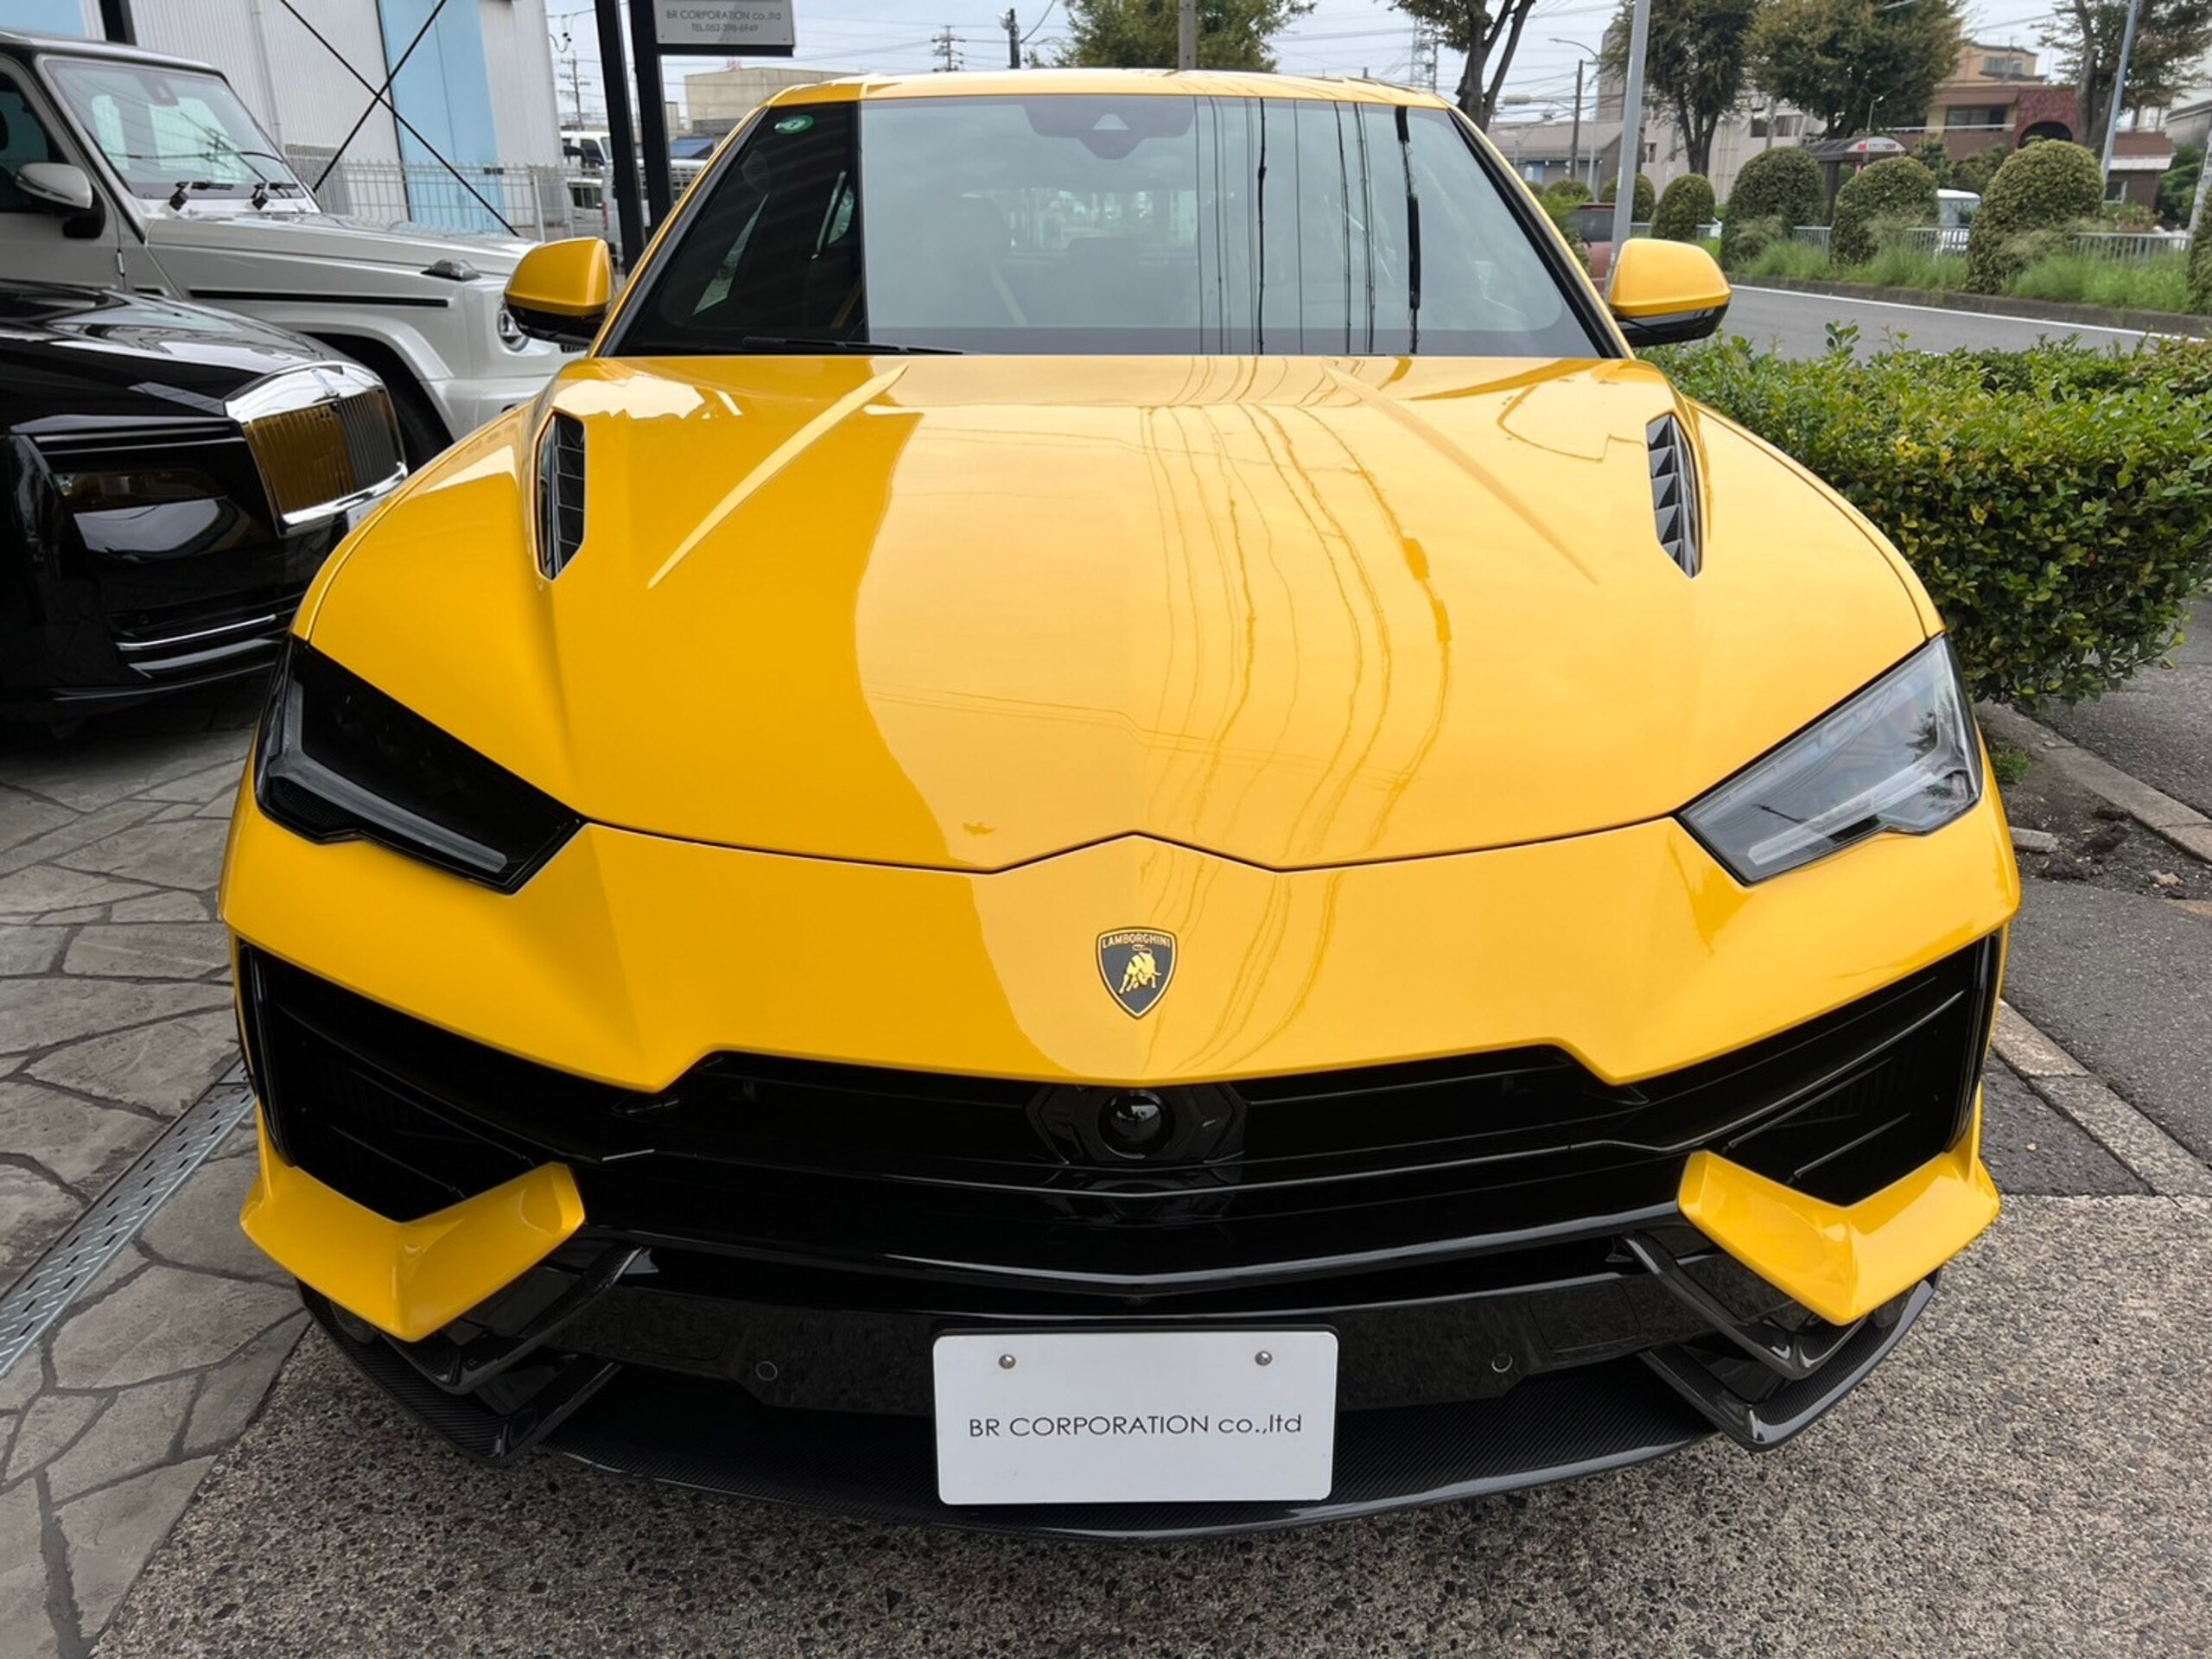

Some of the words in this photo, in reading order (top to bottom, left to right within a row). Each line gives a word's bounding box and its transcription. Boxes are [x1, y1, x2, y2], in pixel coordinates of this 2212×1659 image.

[666, 10, 677, 19] BR
[680, 10, 750, 20] CORPORATION
[1102, 933, 1171, 949] LAMBORGHINI
[969, 1417, 1001, 1438] BR
[1008, 1414, 1209, 1438] CORPORATION
[1217, 1414, 1303, 1436] co.,ltd
